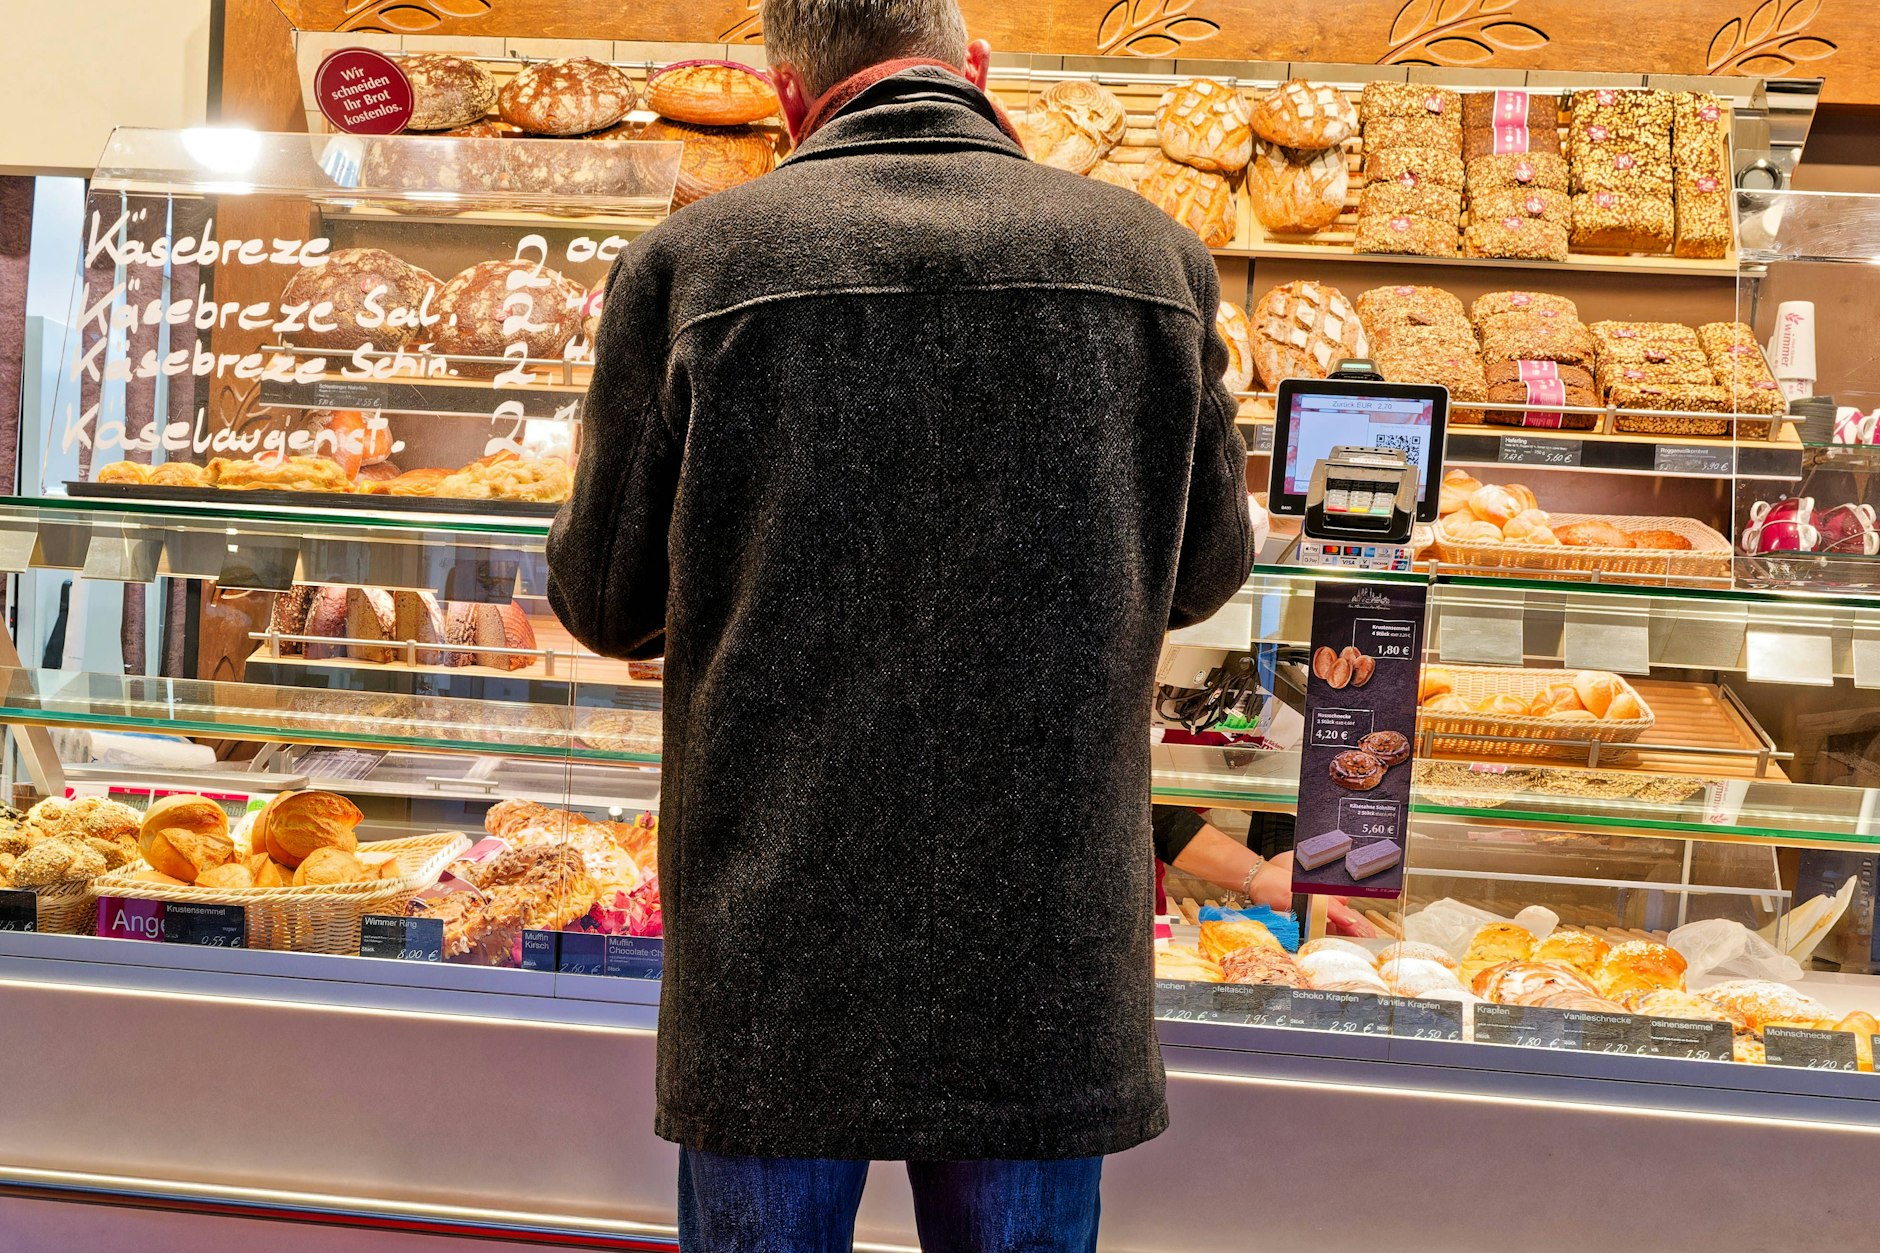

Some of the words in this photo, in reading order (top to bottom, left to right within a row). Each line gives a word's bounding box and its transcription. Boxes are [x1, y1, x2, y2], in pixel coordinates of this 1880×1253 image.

[340, 66, 364, 81] Wir
[331, 76, 390, 100] schneiden
[343, 99, 361, 111] Ihr
[363, 89, 391, 105] Brot
[343, 103, 402, 126] kostenlos.
[85, 208, 330, 268] Käsebreze
[76, 276, 338, 335] Käsebreze
[355, 285, 457, 328] Sal.
[1781, 324, 1792, 367] wimmer
[70, 337, 326, 384] Käsebreze
[341, 342, 458, 379] Schin.
[1505, 437, 1528, 445] Haferling
[1564, 454, 1573, 463] €
[1720, 462, 1729, 471] €
[1378, 645, 1400, 656] 1,80
[1402, 646, 1410, 655] €
[1315, 730, 1338, 740] 4,20
[1341, 731, 1348, 740] €
[1362, 824, 1385, 834] 5,60
[1387, 826, 1395, 835] €
[166, 905, 225, 916] Krustensemmel
[365, 917, 397, 927] Wimmer
[399, 919, 418, 930] Ring
[231, 937, 241, 947] €
[525, 933, 549, 941] Muffin
[609, 938, 634, 946] Muffin
[525, 941, 550, 950] Kirsch
[609, 946, 649, 956] Chocolate
[397, 949, 423, 959] 8,00
[428, 950, 438, 961] €
[591, 965, 601, 975] €
[1213, 986, 1254, 994] pfeltasche
[1292, 990, 1324, 1000] Schoko
[1326, 993, 1359, 1003] Krapfen
[1407, 1000, 1440, 1010] Krapfen
[1477, 1006, 1511, 1015] Krapfen
[1163, 1009, 1192, 1020] 2,20
[1197, 1011, 1208, 1022] €
[1276, 1015, 1287, 1026] €
[1563, 1012, 1632, 1024] Vanilleschnecke
[1329, 1021, 1357, 1032] 2,50
[1363, 1023, 1374, 1034] €
[1650, 1020, 1713, 1031] osinensemmel
[1414, 1029, 1442, 1039] 2,50
[1448, 1030, 1459, 1040] €
[1766, 1027, 1832, 1040] Mohnschnecke
[1516, 1036, 1542, 1047] 1,80
[1549, 1038, 1560, 1048] €
[1636, 1045, 1647, 1055] €
[1685, 1049, 1710, 1060] 1,50
[1719, 1051, 1730, 1062] €
[1807, 1058, 1838, 1070] 2,20
[1843, 1060, 1855, 1071] €
